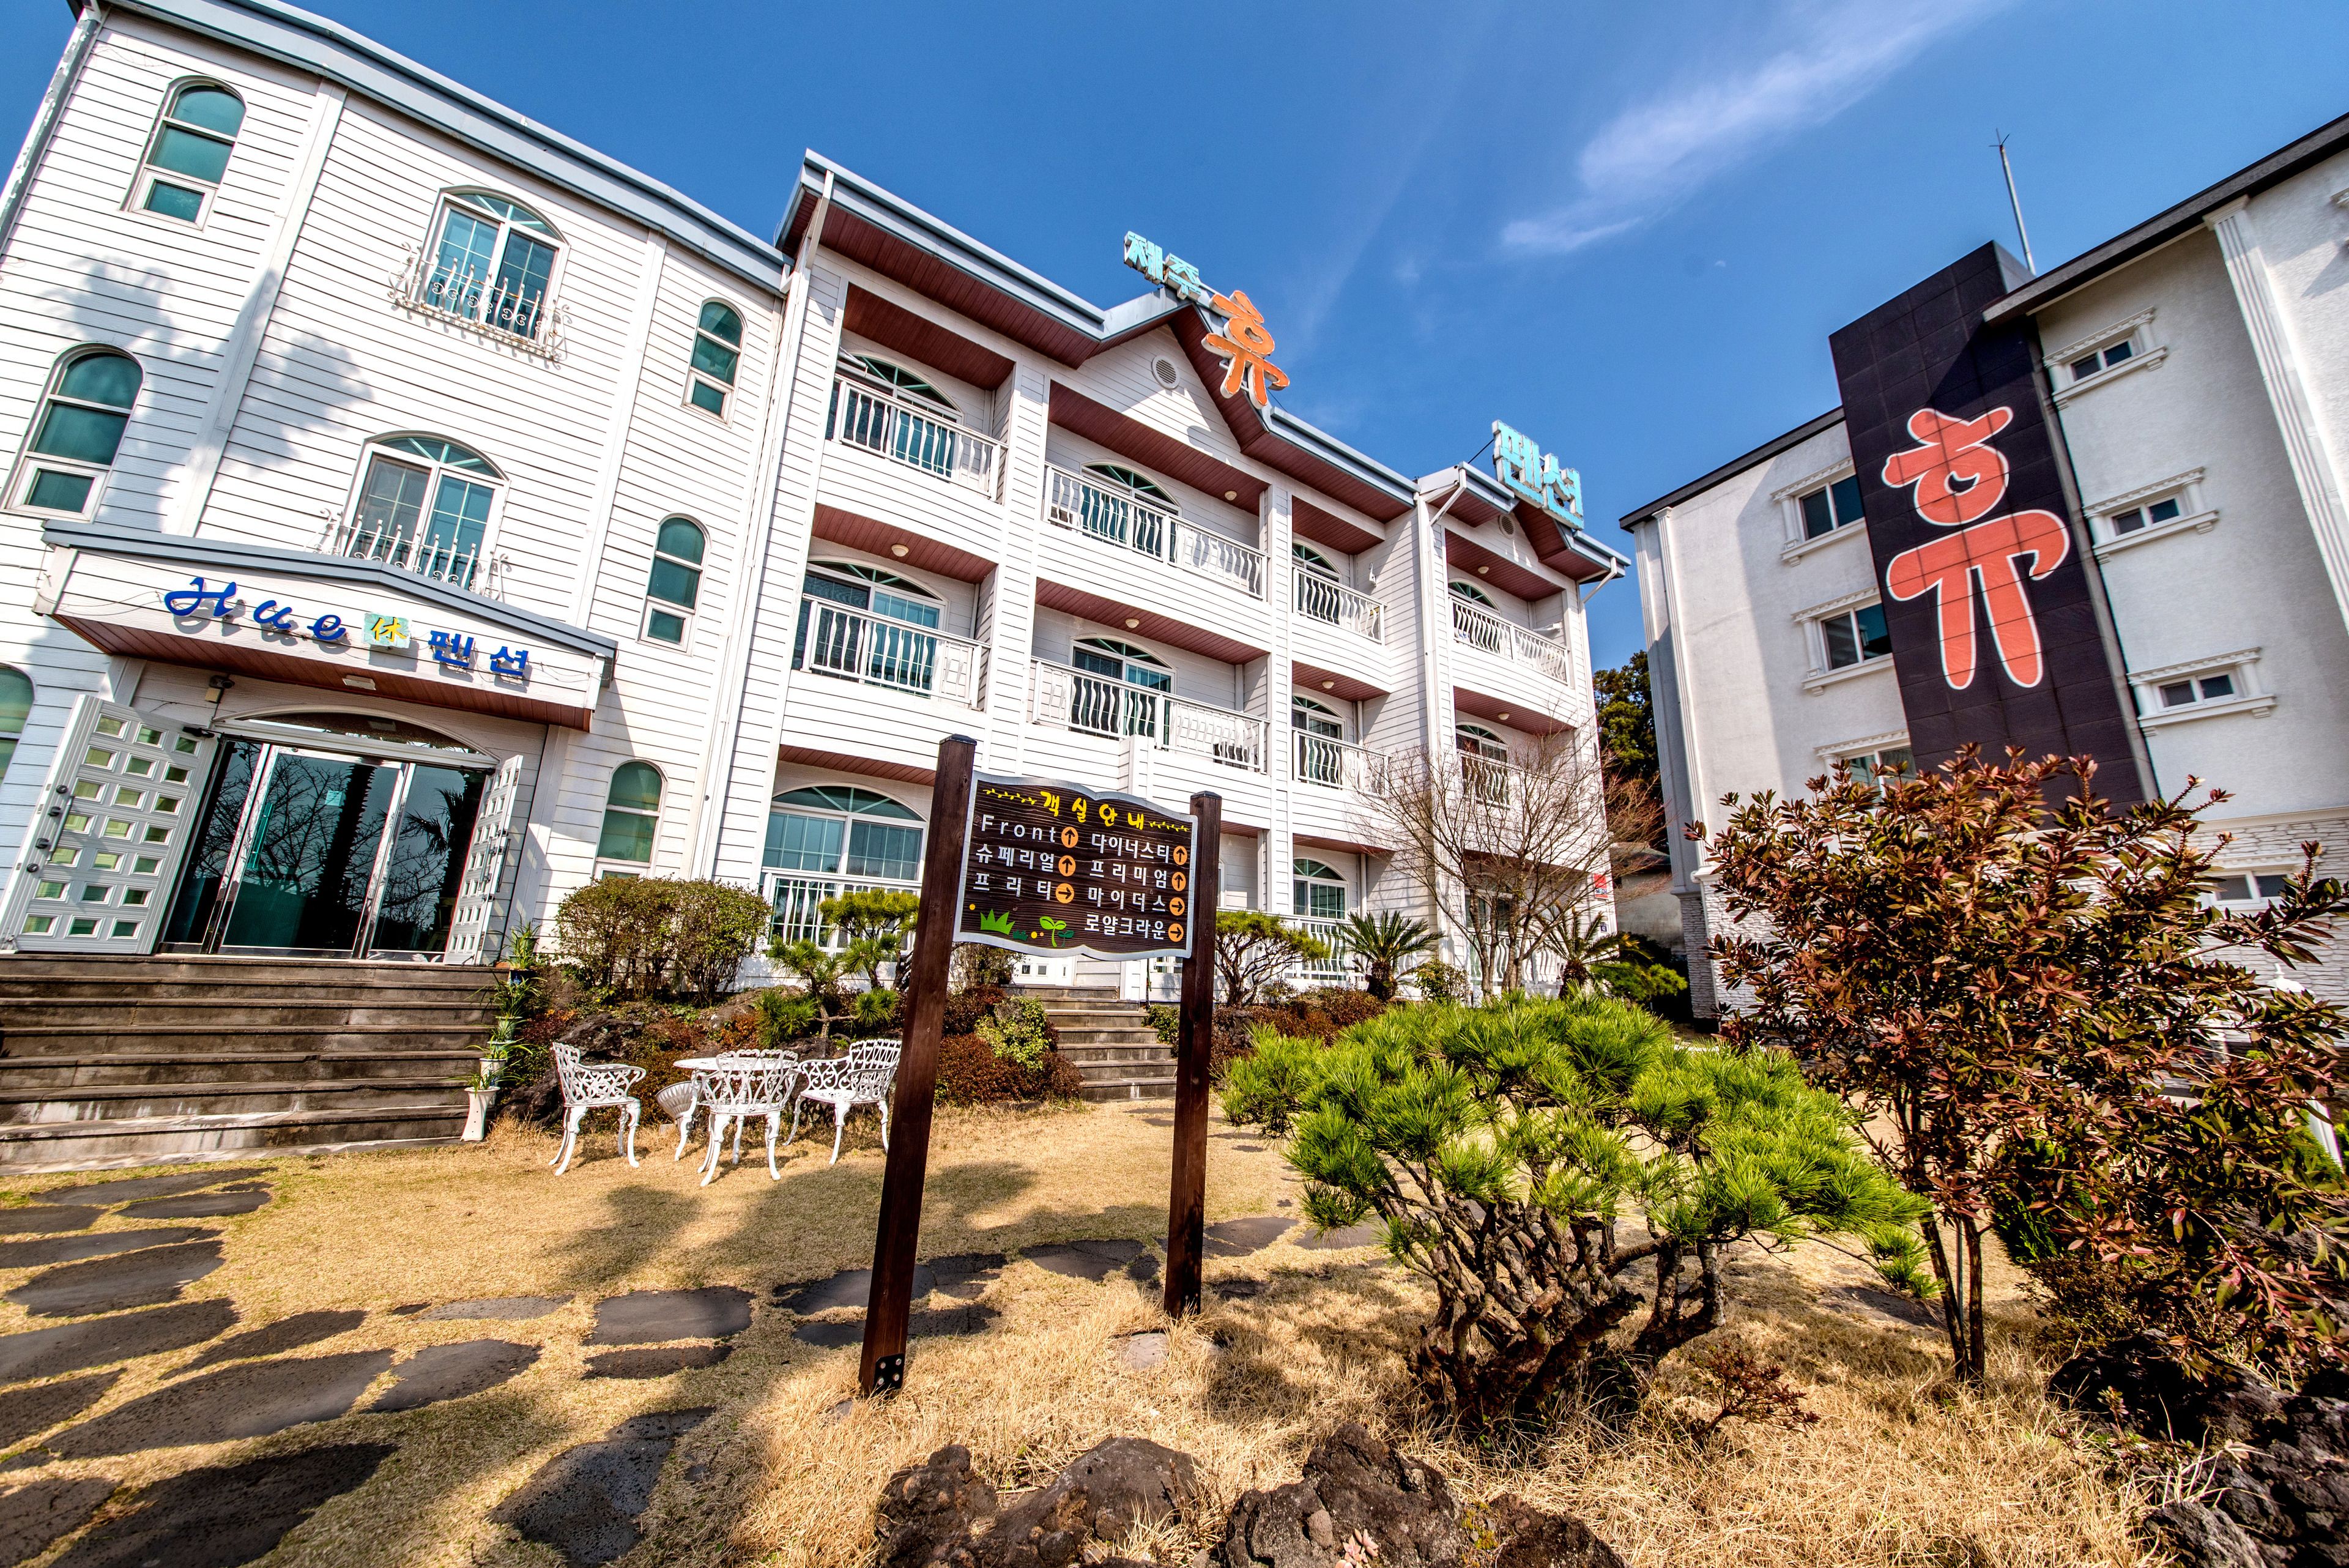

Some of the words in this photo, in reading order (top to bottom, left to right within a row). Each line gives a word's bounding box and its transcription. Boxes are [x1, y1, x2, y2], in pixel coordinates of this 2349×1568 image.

[1124, 231, 1203, 299] 제주
[1201, 289, 1290, 410] 휴
[1493, 420, 1585, 531] 펜션
[1882, 406, 2069, 689] 휴
[164, 576, 347, 642] Hue
[371, 618, 407, 643] 休
[428, 629, 529, 677] 펜션
[981, 814, 1056, 843] Front
[975, 843, 1055, 873] 슈페리얼
[1091, 833, 1170, 864] 다이너스티
[1089, 860, 1167, 890] 프리미엄
[1087, 887, 1167, 913] 마이더스
[1083, 913, 1167, 941] 로얄크라운
